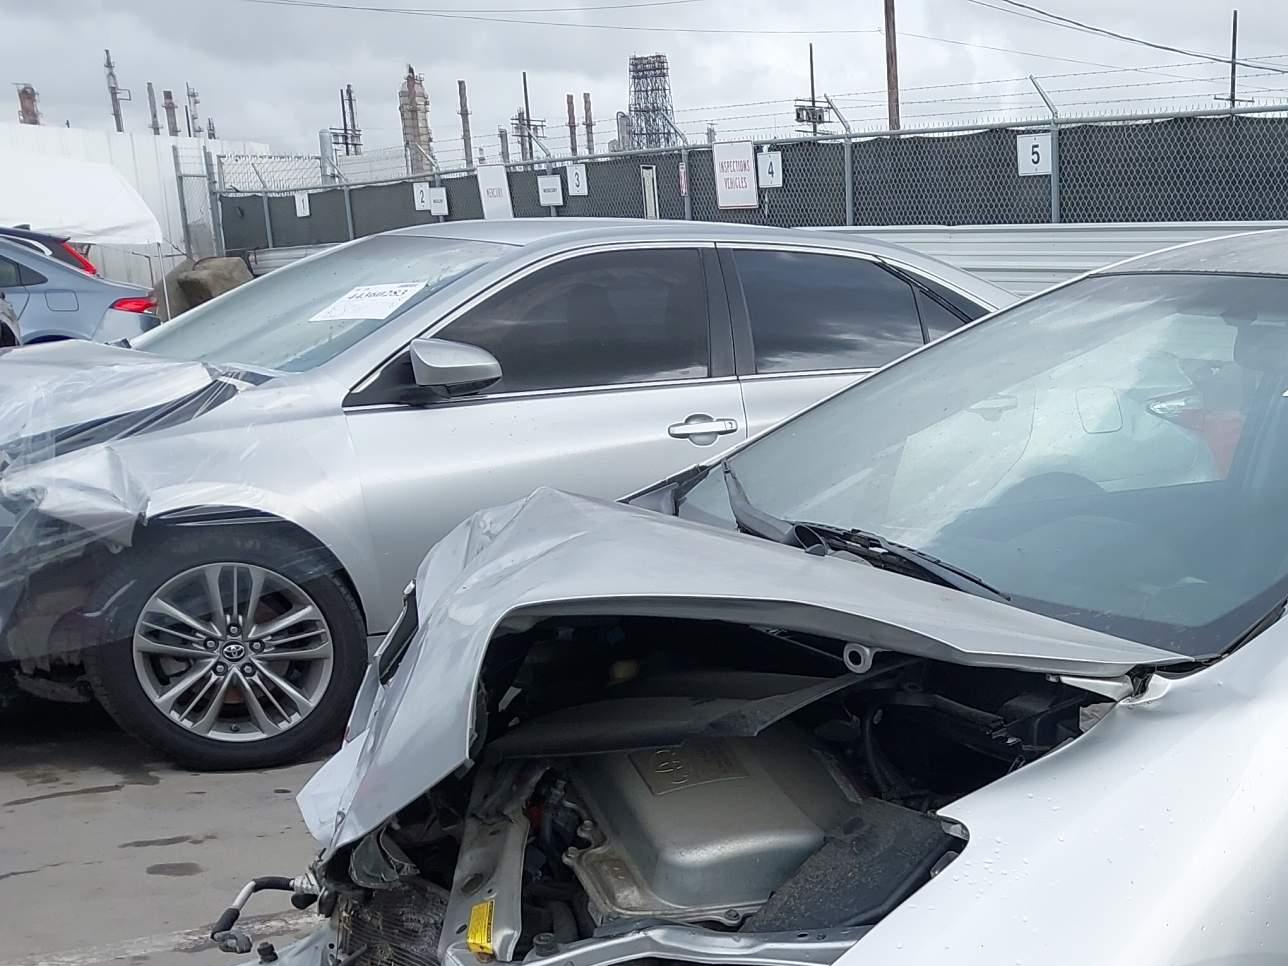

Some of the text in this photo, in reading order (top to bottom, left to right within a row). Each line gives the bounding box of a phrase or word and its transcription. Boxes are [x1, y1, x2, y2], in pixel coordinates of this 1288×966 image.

[1031, 144, 1041, 165] 5
[719, 160, 751, 174] INSPECTIONS
[768, 161, 775, 178] 4
[574, 172, 581, 188] 3
[724, 177, 748, 190] VEHICLES
[420, 190, 425, 204] 2
